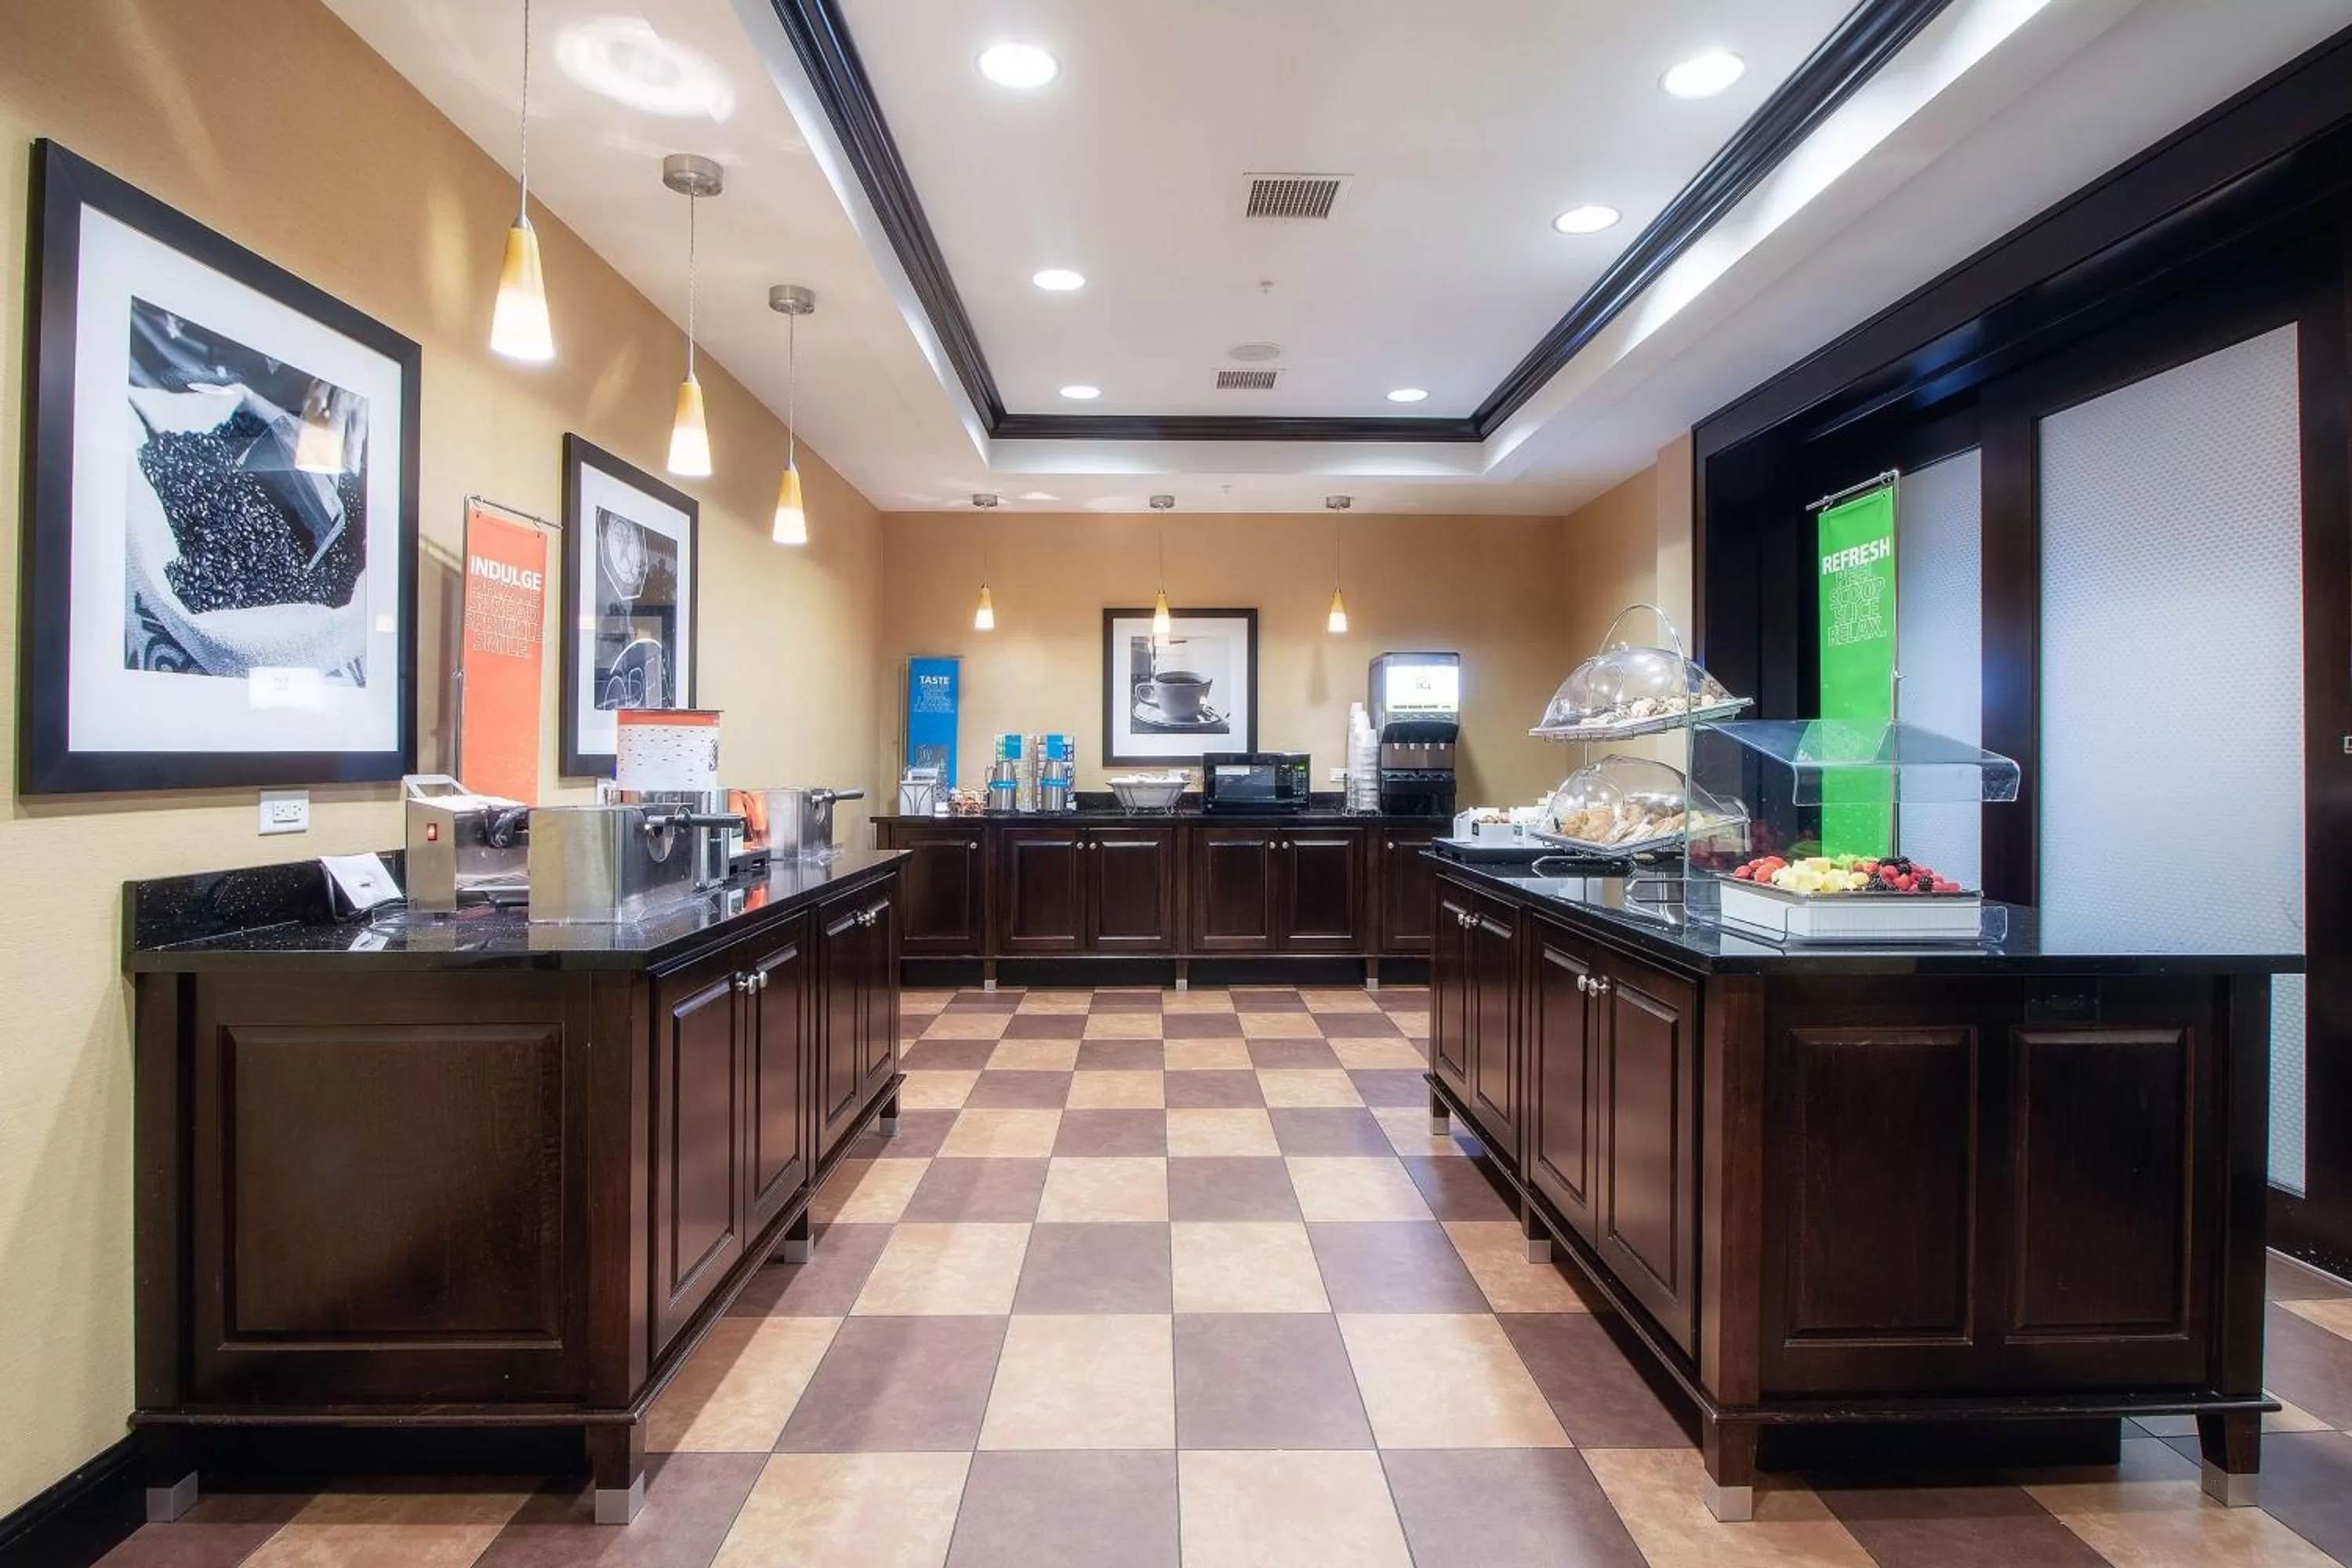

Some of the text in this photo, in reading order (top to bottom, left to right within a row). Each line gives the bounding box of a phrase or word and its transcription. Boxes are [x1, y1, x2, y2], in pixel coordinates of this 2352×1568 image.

[470, 555, 542, 591] INDULGE
[1822, 536, 1890, 575] REFRESH
[919, 675, 950, 684] TASTE
